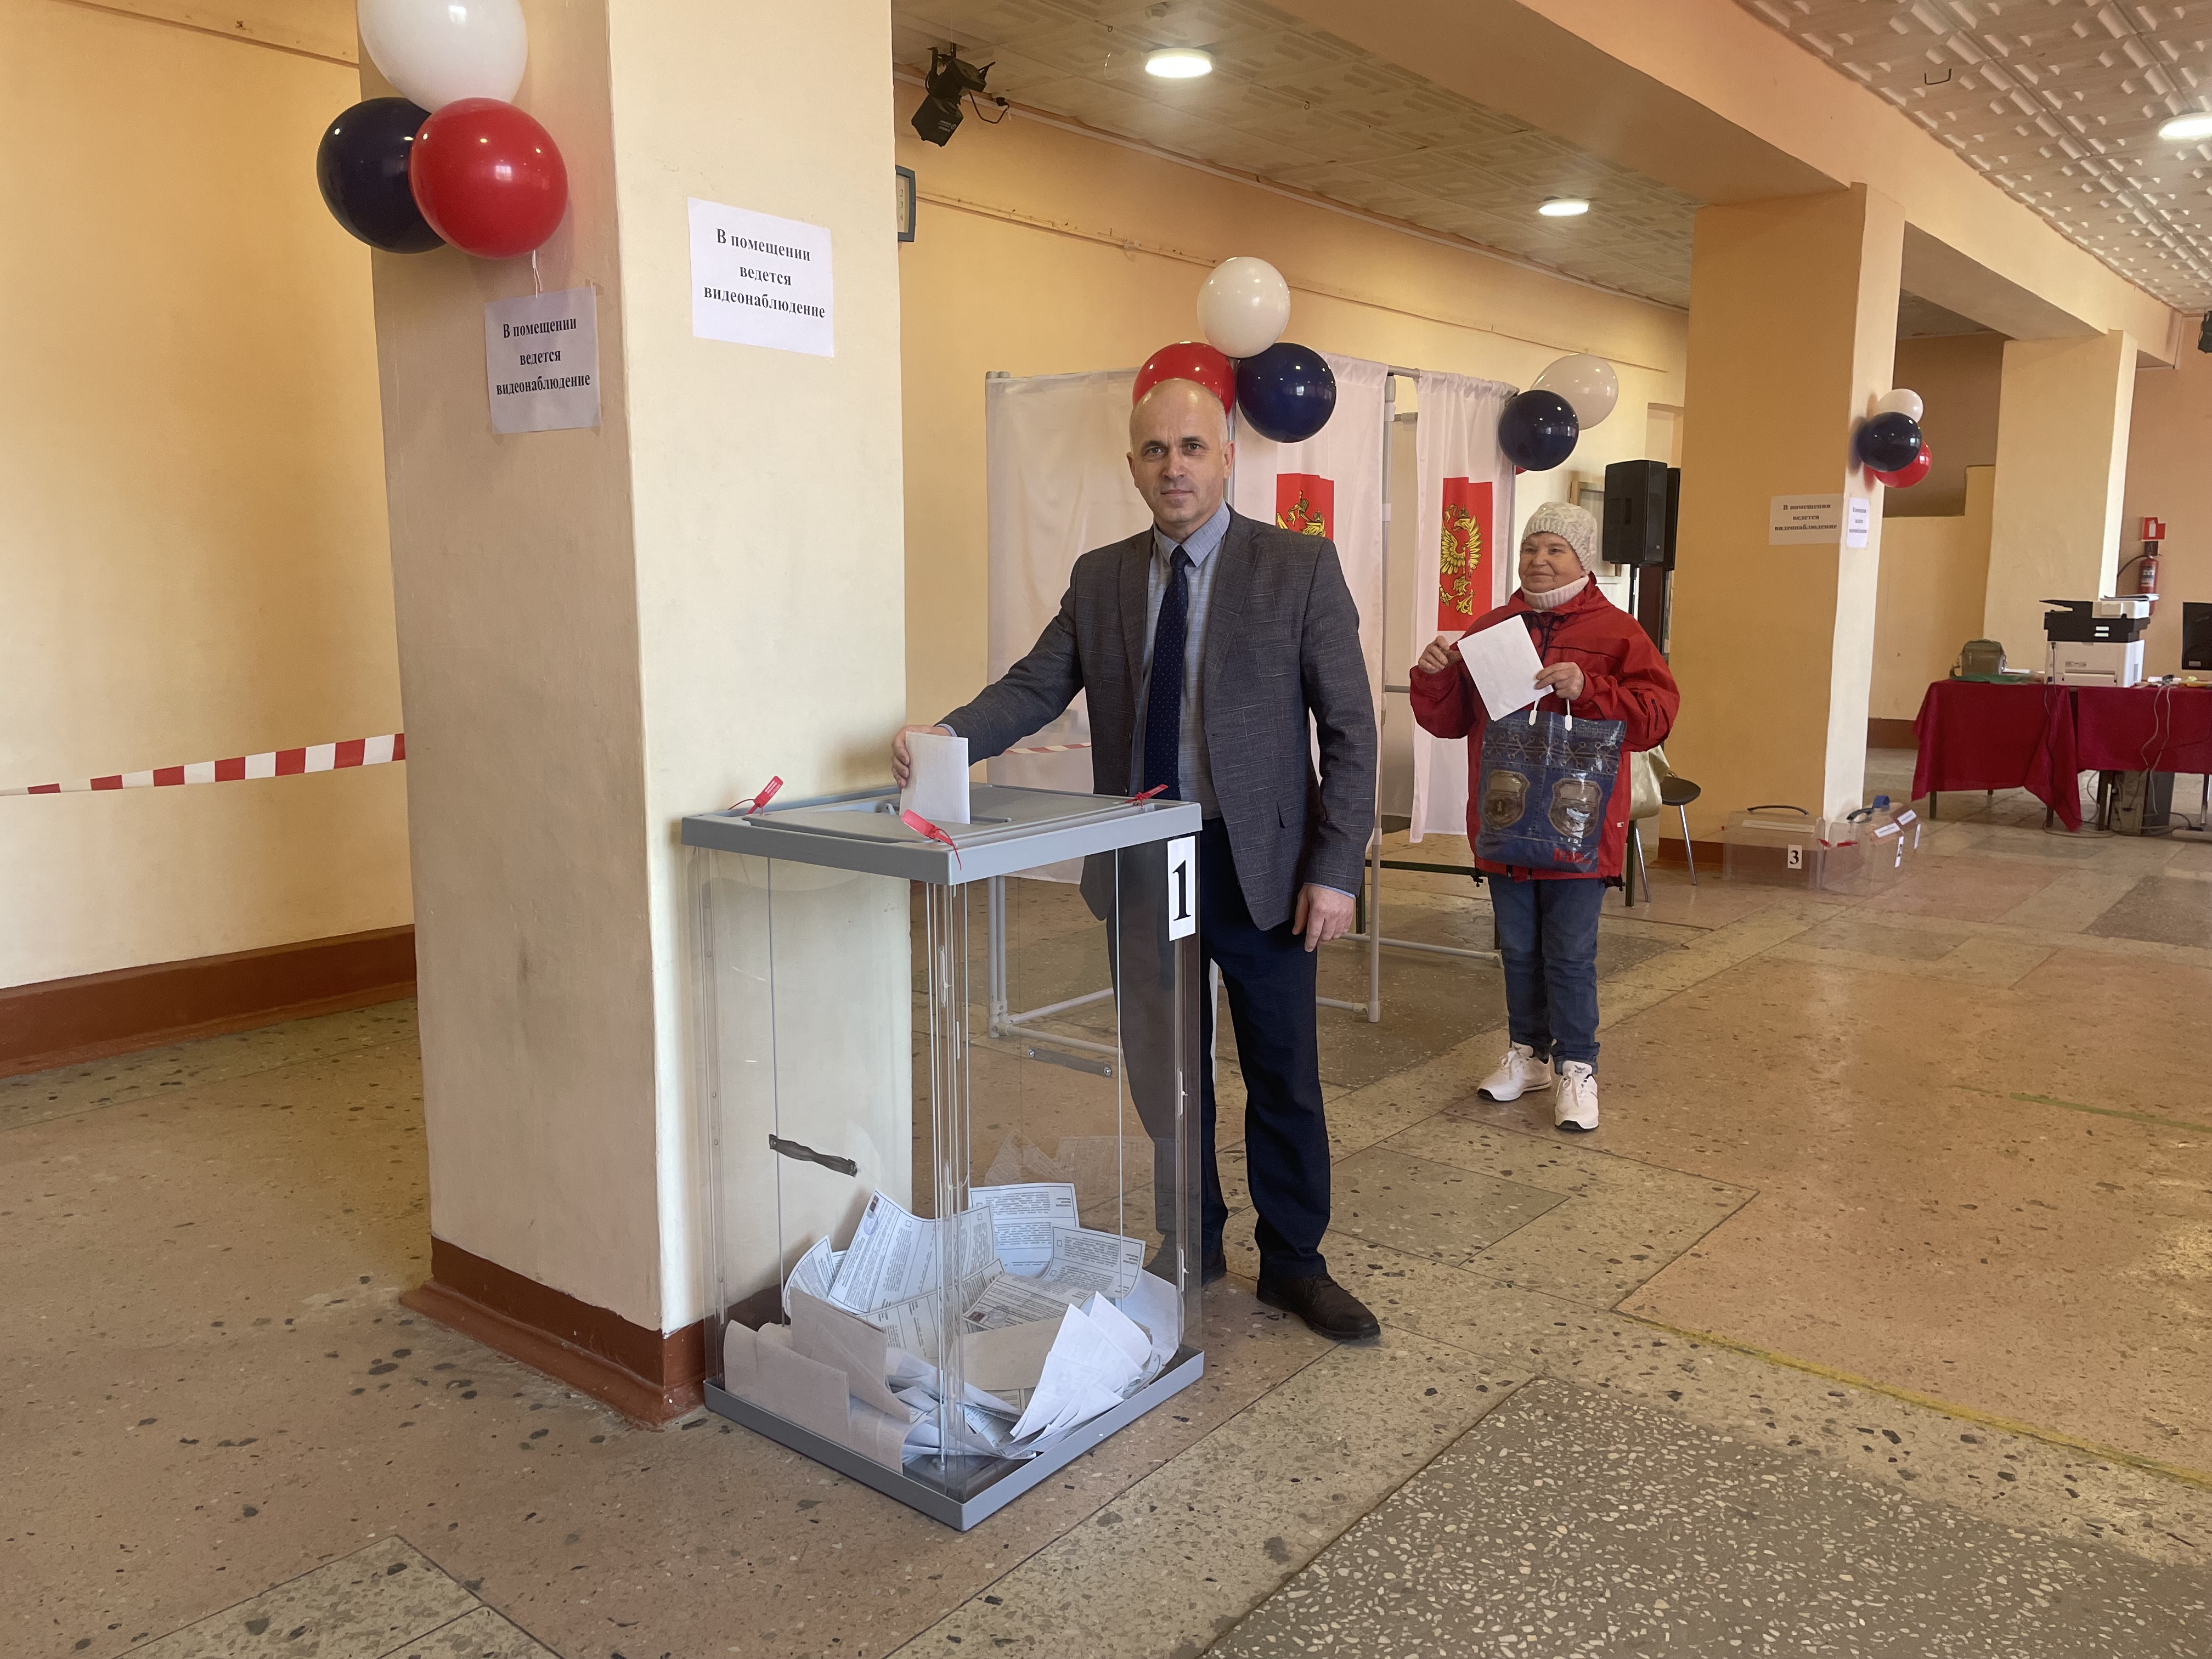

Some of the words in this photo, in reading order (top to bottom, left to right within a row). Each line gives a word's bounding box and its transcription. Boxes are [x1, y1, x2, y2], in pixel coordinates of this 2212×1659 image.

[716, 228, 726, 244] В
[731, 235, 810, 261] помещении
[740, 266, 791, 286] ведется
[704, 286, 825, 318] видеонаблюдение
[503, 323, 510, 338] В
[513, 318, 577, 337] помещении
[520, 351, 561, 365] ведется
[496, 375, 590, 396] видеонаблюдение
[1790, 850, 1799, 865] 3
[1172, 860, 1191, 921] 1
